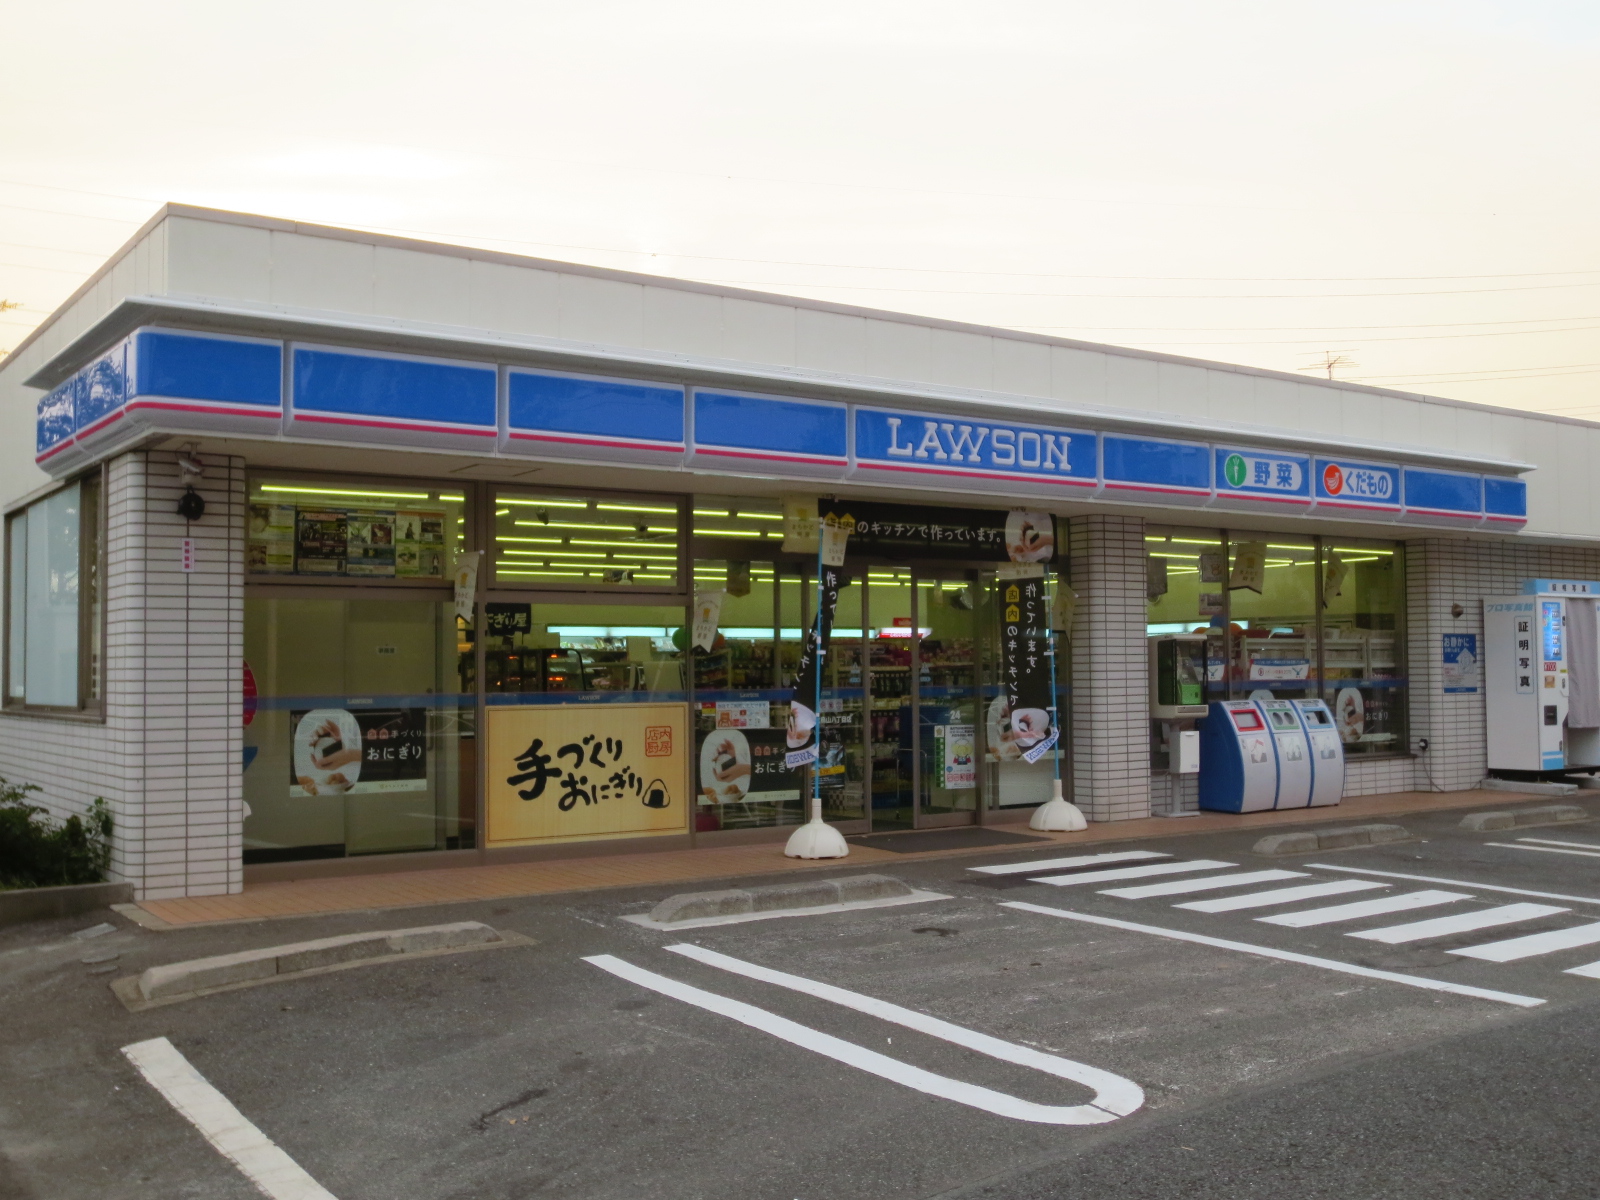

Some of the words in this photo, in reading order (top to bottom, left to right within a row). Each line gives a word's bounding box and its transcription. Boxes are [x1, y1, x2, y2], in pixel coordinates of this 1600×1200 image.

[887, 417, 1072, 472] LAWSON
[1253, 461, 1293, 488] 野菜
[1344, 471, 1389, 496] くだもの
[1518, 621, 1530, 688] 証明写真
[950, 710, 961, 720] 24
[367, 743, 422, 760] おにぎり
[506, 734, 623, 801] 手づくり
[558, 765, 643, 811] おにぎり
